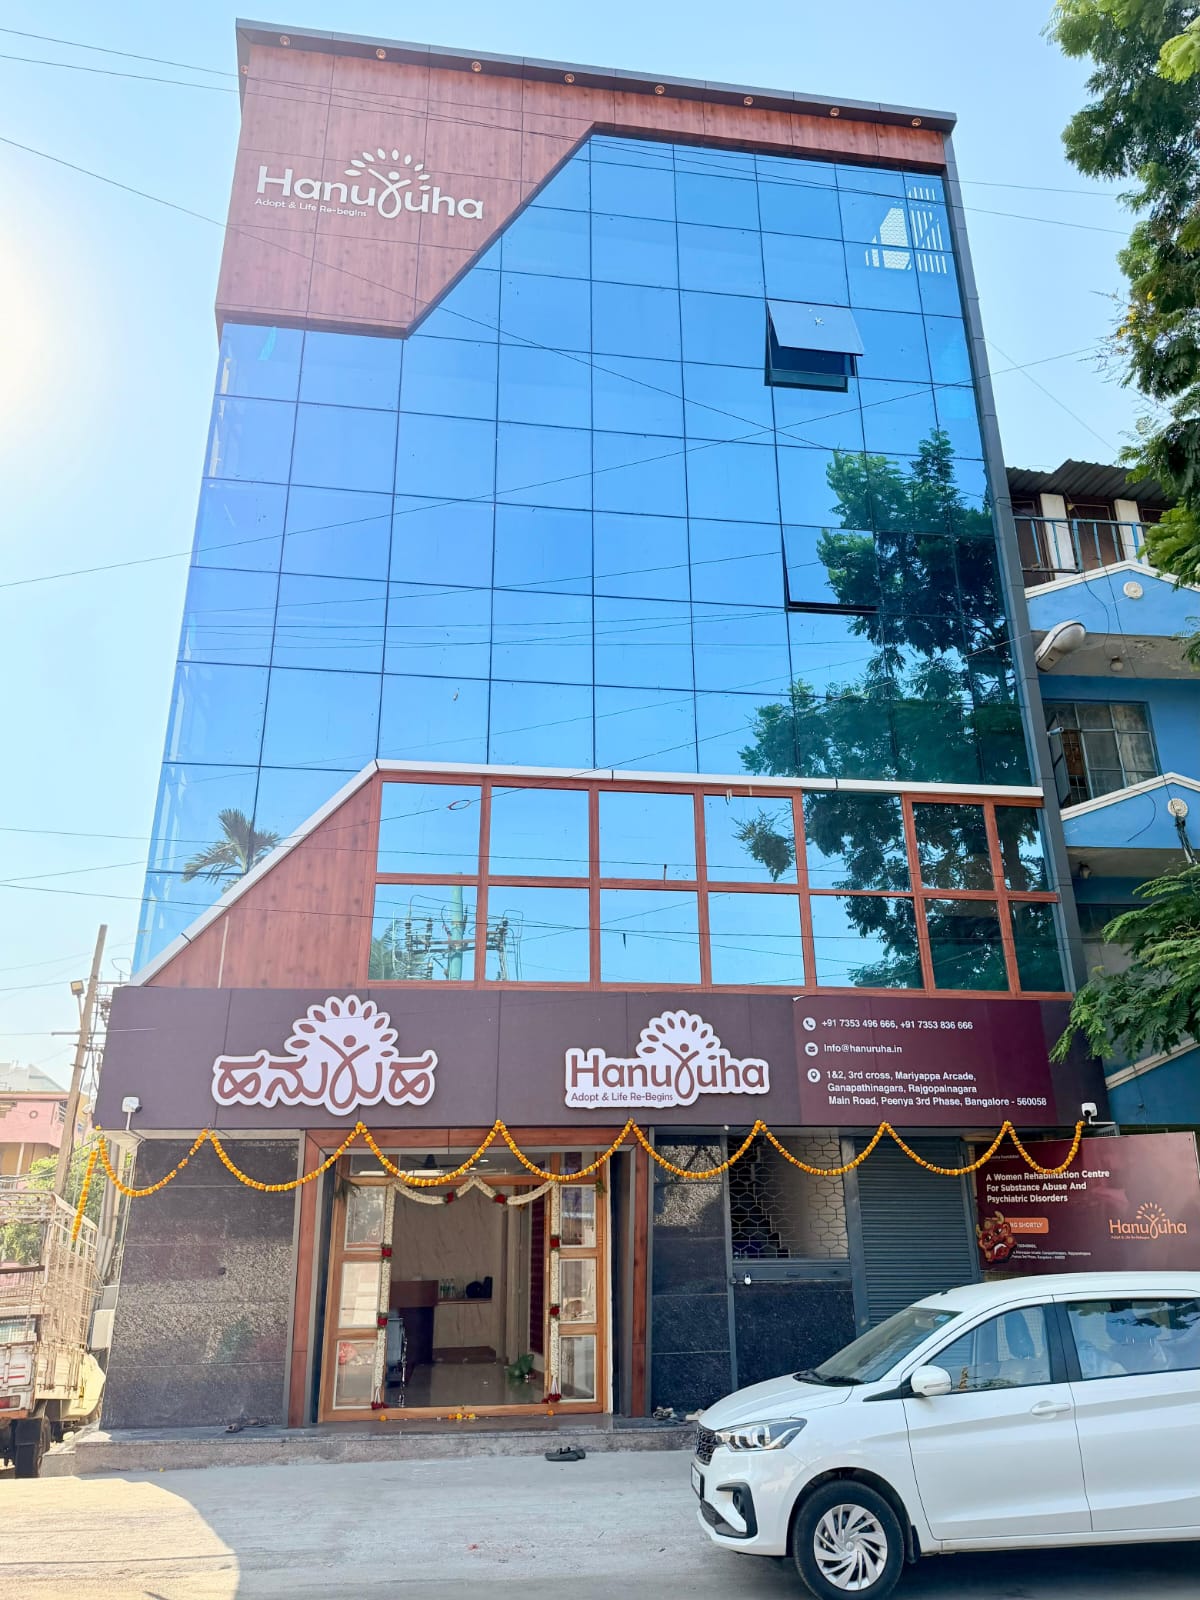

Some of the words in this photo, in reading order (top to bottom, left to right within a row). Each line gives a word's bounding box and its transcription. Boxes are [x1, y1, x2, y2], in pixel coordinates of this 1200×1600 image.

[255, 198, 286, 208] Adopt
[300, 203, 316, 211] Life
[821, 1019, 837, 1027] +91
[839, 1019, 860, 1028] 7353
[862, 1019, 878, 1028] 496
[880, 1020, 898, 1029] 666,
[900, 1020, 915, 1029] +91
[918, 1020, 938, 1029] 7353
[940, 1021, 956, 1030] 836
[957, 1021, 974, 1030] 666
[826, 1070, 846, 1080] 1&2,
[848, 1071, 863, 1079] 3rd
[865, 1072, 893, 1080] cross,
[895, 1071, 940, 1082] Mariyappa
[942, 1071, 977, 1081] Arcade,
[827, 1083, 907, 1094] Ganapathinagara,
[571, 1092, 599, 1102] Adopt
[601, 1093, 609, 1101] &
[611, 1092, 628, 1101] Life
[630, 1092, 673, 1102] Re-Begins
[828, 1096, 851, 1105] Main
[853, 1096, 879, 1106] Road,
[881, 1096, 914, 1107] Peenya
[915, 1096, 931, 1105] 3rd
[932, 1097, 963, 1107] Phase,
[964, 1097, 1010, 1108] Bangalore
[1016, 1097, 1047, 1106] 560058
[993, 1173, 1023, 1181] Women
[1081, 1169, 1110, 1179] Centre
[986, 1184, 999, 1192] For
[1000, 1183, 1040, 1191] Substance
[1042, 1183, 1068, 1191] Abuse
[1069, 1182, 1087, 1190] And
[987, 1194, 1029, 1204] Psychiatric
[1030, 1194, 1069, 1203] Disorders
